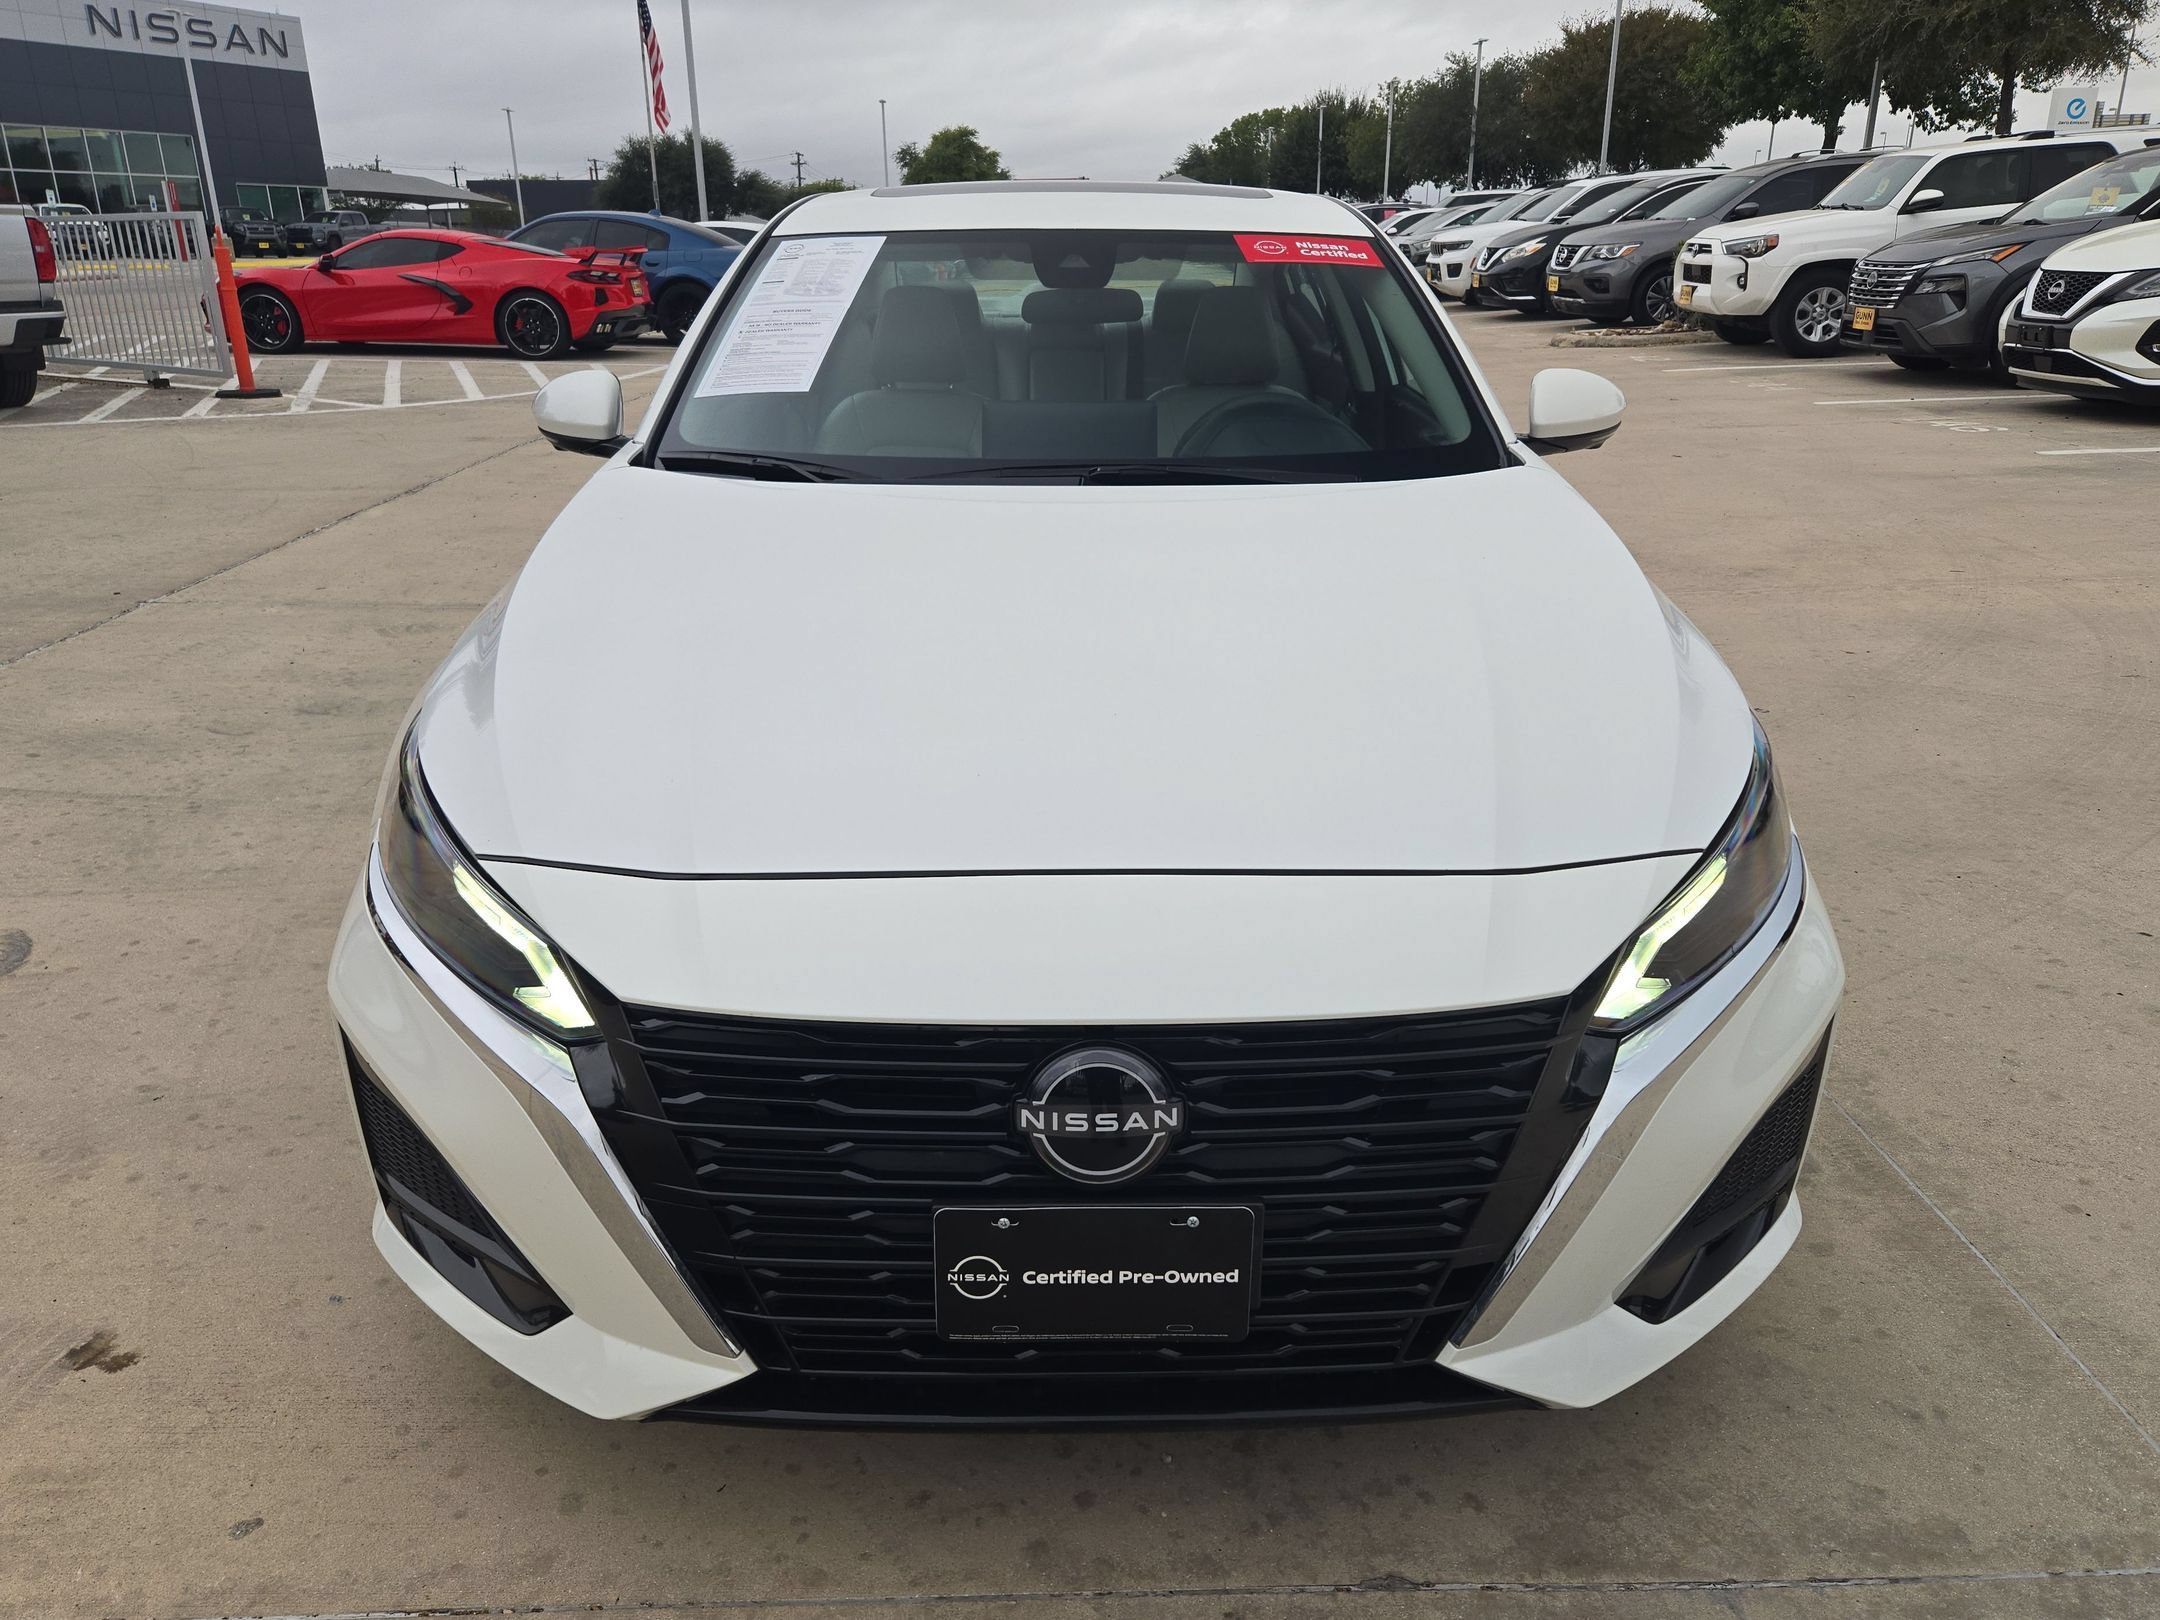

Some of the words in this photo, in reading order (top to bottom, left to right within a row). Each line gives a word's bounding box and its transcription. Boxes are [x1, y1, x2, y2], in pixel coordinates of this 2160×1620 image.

[86, 4, 289, 58] NISSAN
[1295, 241, 1349, 251] Nissan
[1300, 249, 1368, 260] Certified
[1856, 311, 1873, 320] GUNN
[1020, 1107, 1178, 1132] NISSAN
[948, 1273, 1009, 1282] NISSAN
[1022, 1269, 1113, 1285] Certified
[1119, 1269, 1239, 1284] Pre-Owned
